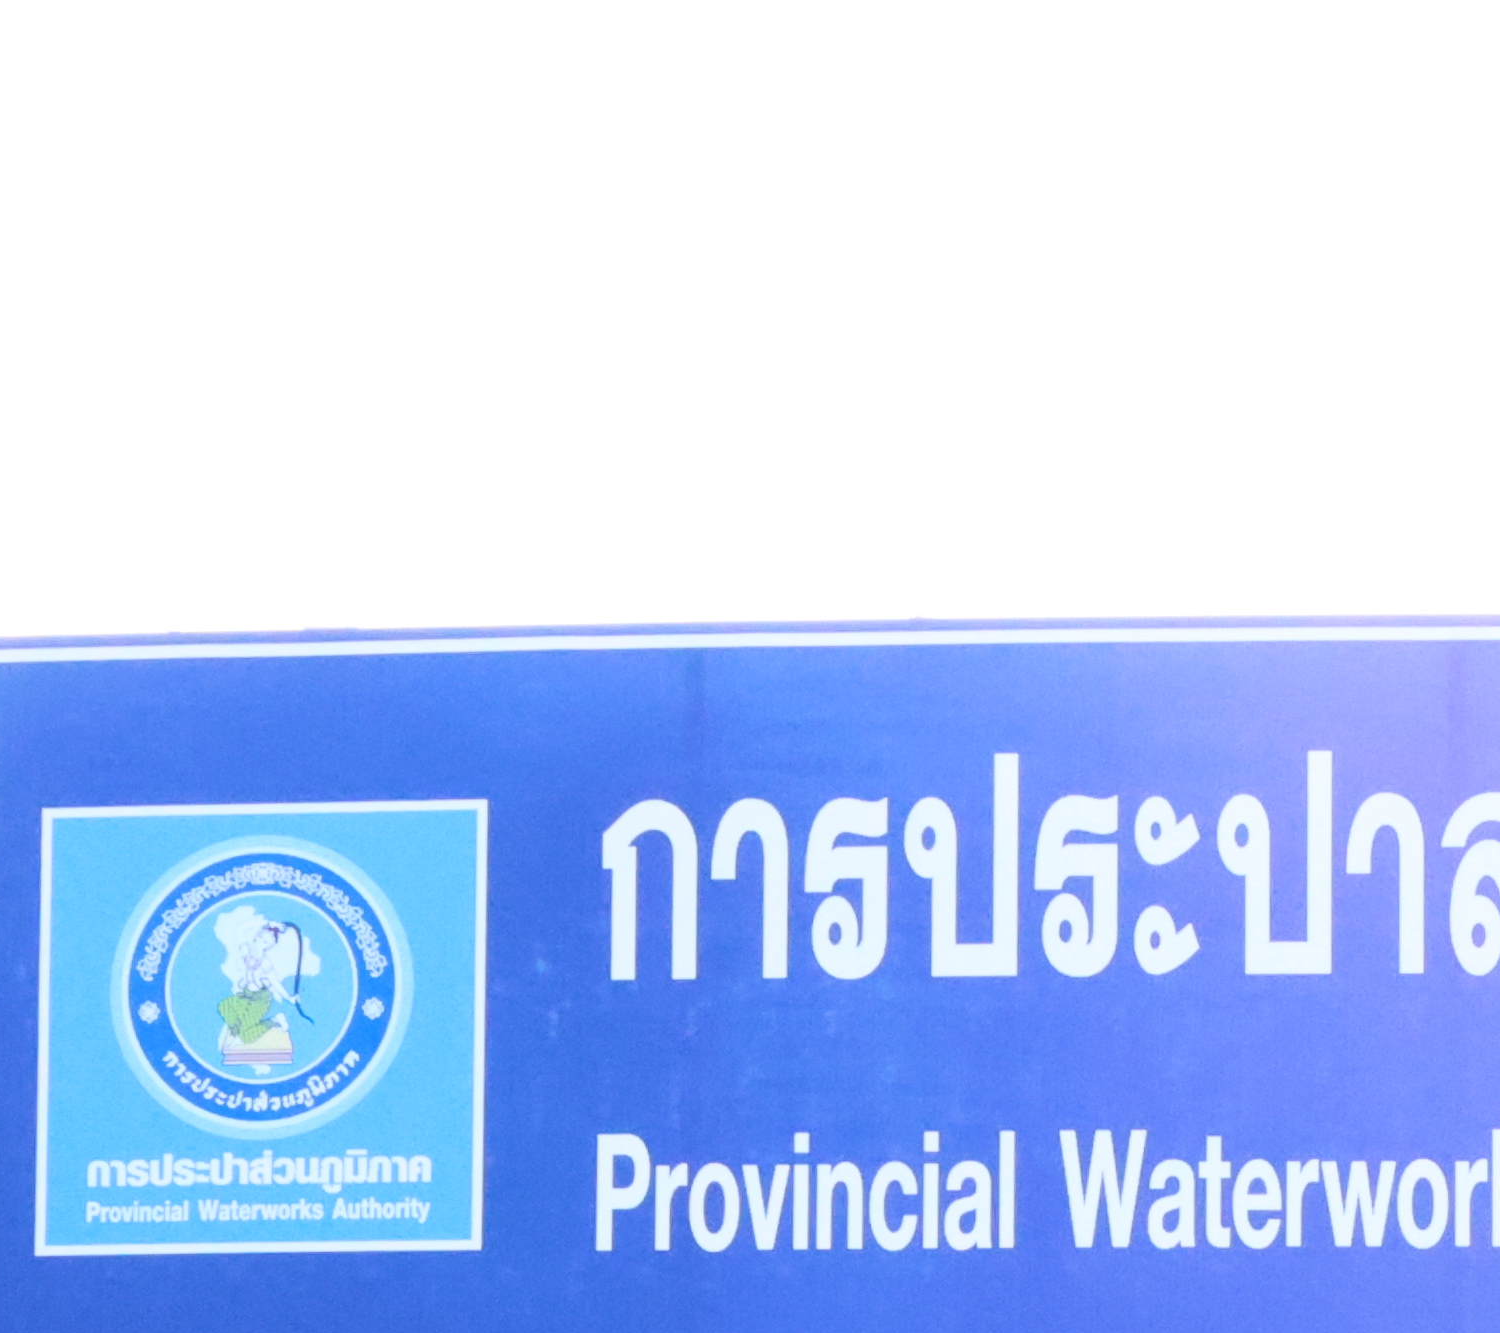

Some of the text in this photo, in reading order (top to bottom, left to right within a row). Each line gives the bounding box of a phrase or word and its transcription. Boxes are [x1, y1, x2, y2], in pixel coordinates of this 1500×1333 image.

[87, 1149, 432, 1193] การประปาส่วนภูมิภาค
[595, 1130, 1016, 1252] Provincial
[86, 1197, 431, 1223] Provincial Waterworks Authority
